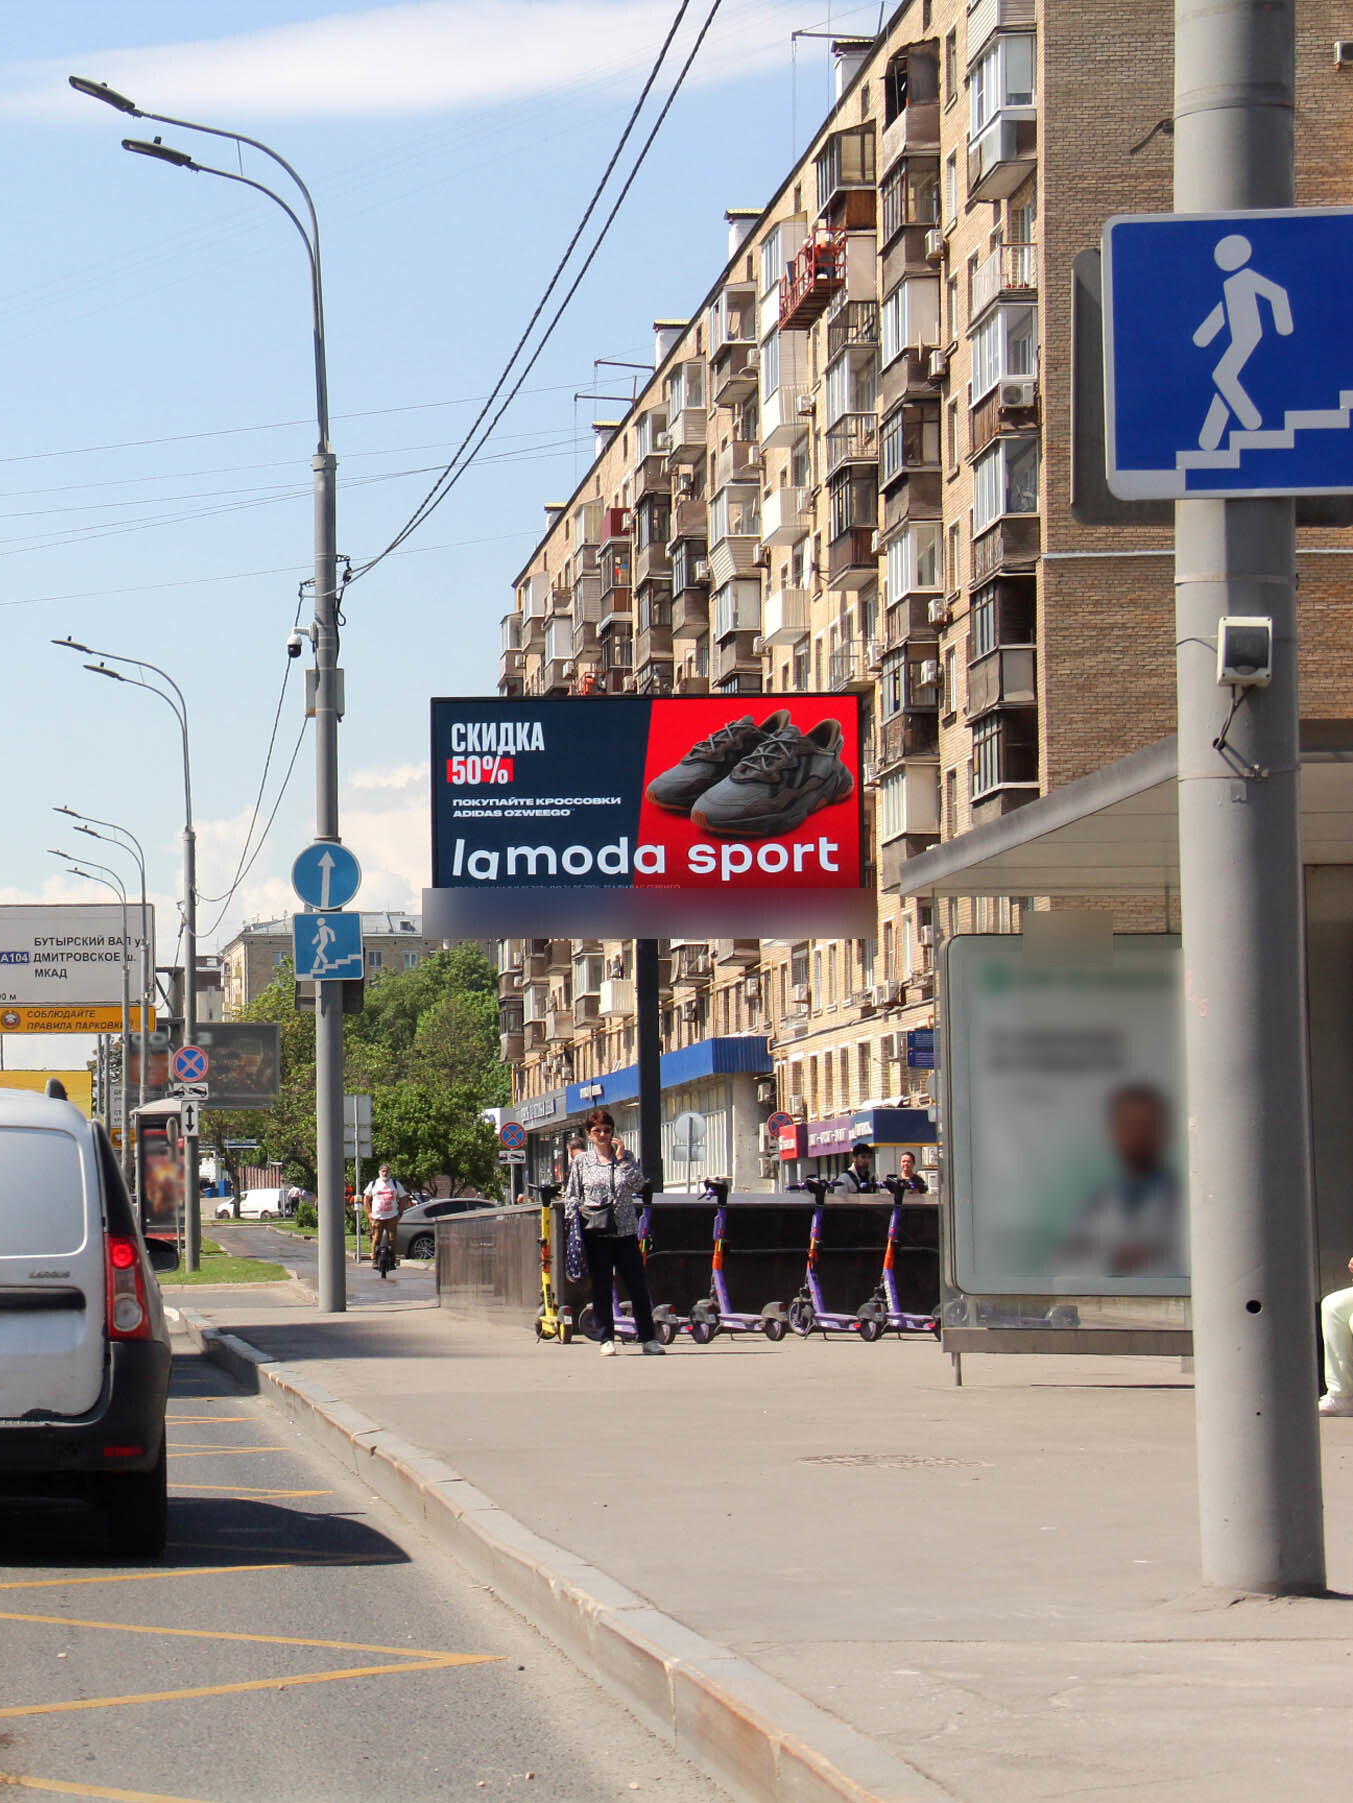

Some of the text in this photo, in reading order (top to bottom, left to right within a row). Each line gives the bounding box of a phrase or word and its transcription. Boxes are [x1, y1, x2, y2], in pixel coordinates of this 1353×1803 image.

[451, 722, 544, 756] СКИДКА
[452, 755, 508, 785] 50%
[452, 797, 621, 807] ПОКУПАЙТЕ КРОССОВКИ
[453, 809, 570, 817] ADIDAS OZWEEGO
[452, 836, 839, 881] lamoda sport
[34, 936, 105, 947] БУТЫРСКИЙ
[0, 952, 29, 963] А104
[33, 952, 120, 963] ДМИТРОВСКОЕ
[34, 969, 68, 979] МКАД
[27, 1010, 96, 1019] СОБЛЮДАЙТЕ
[27, 1021, 72, 1030] ПРАВИЛА
